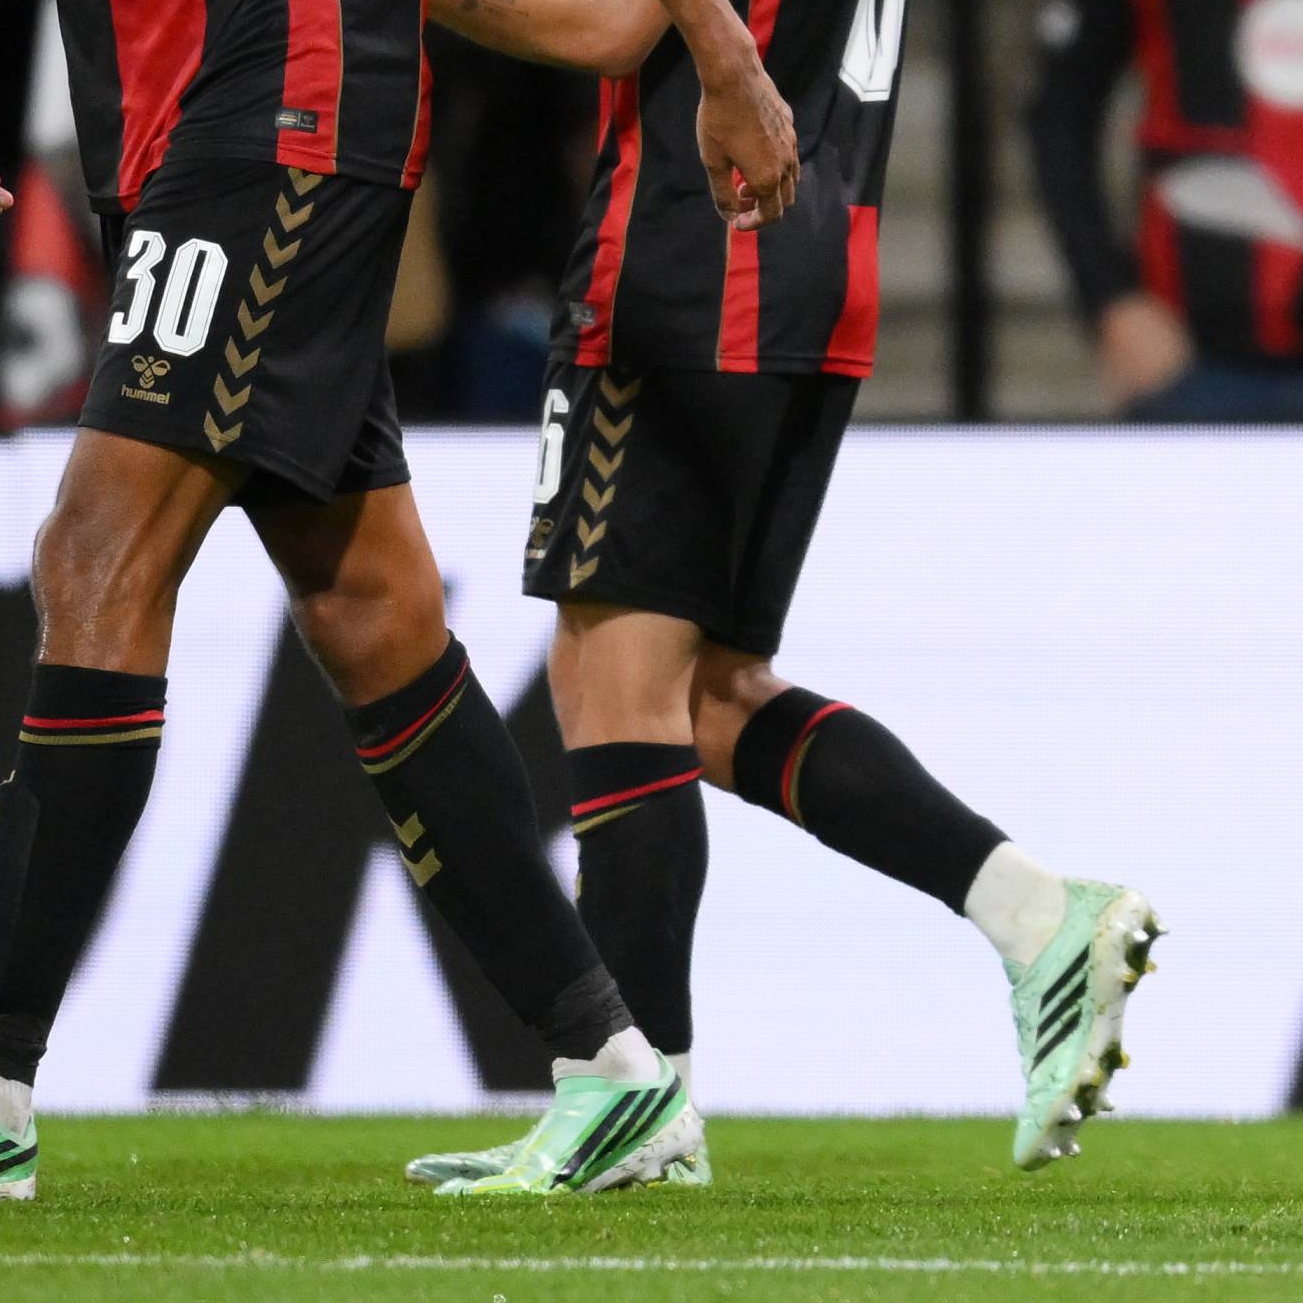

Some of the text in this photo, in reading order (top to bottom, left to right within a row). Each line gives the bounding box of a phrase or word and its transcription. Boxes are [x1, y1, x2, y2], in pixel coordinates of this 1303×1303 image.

[108, 230, 228, 357] 30
[121, 383, 170, 405] hummel
[534, 389, 569, 504] 6
